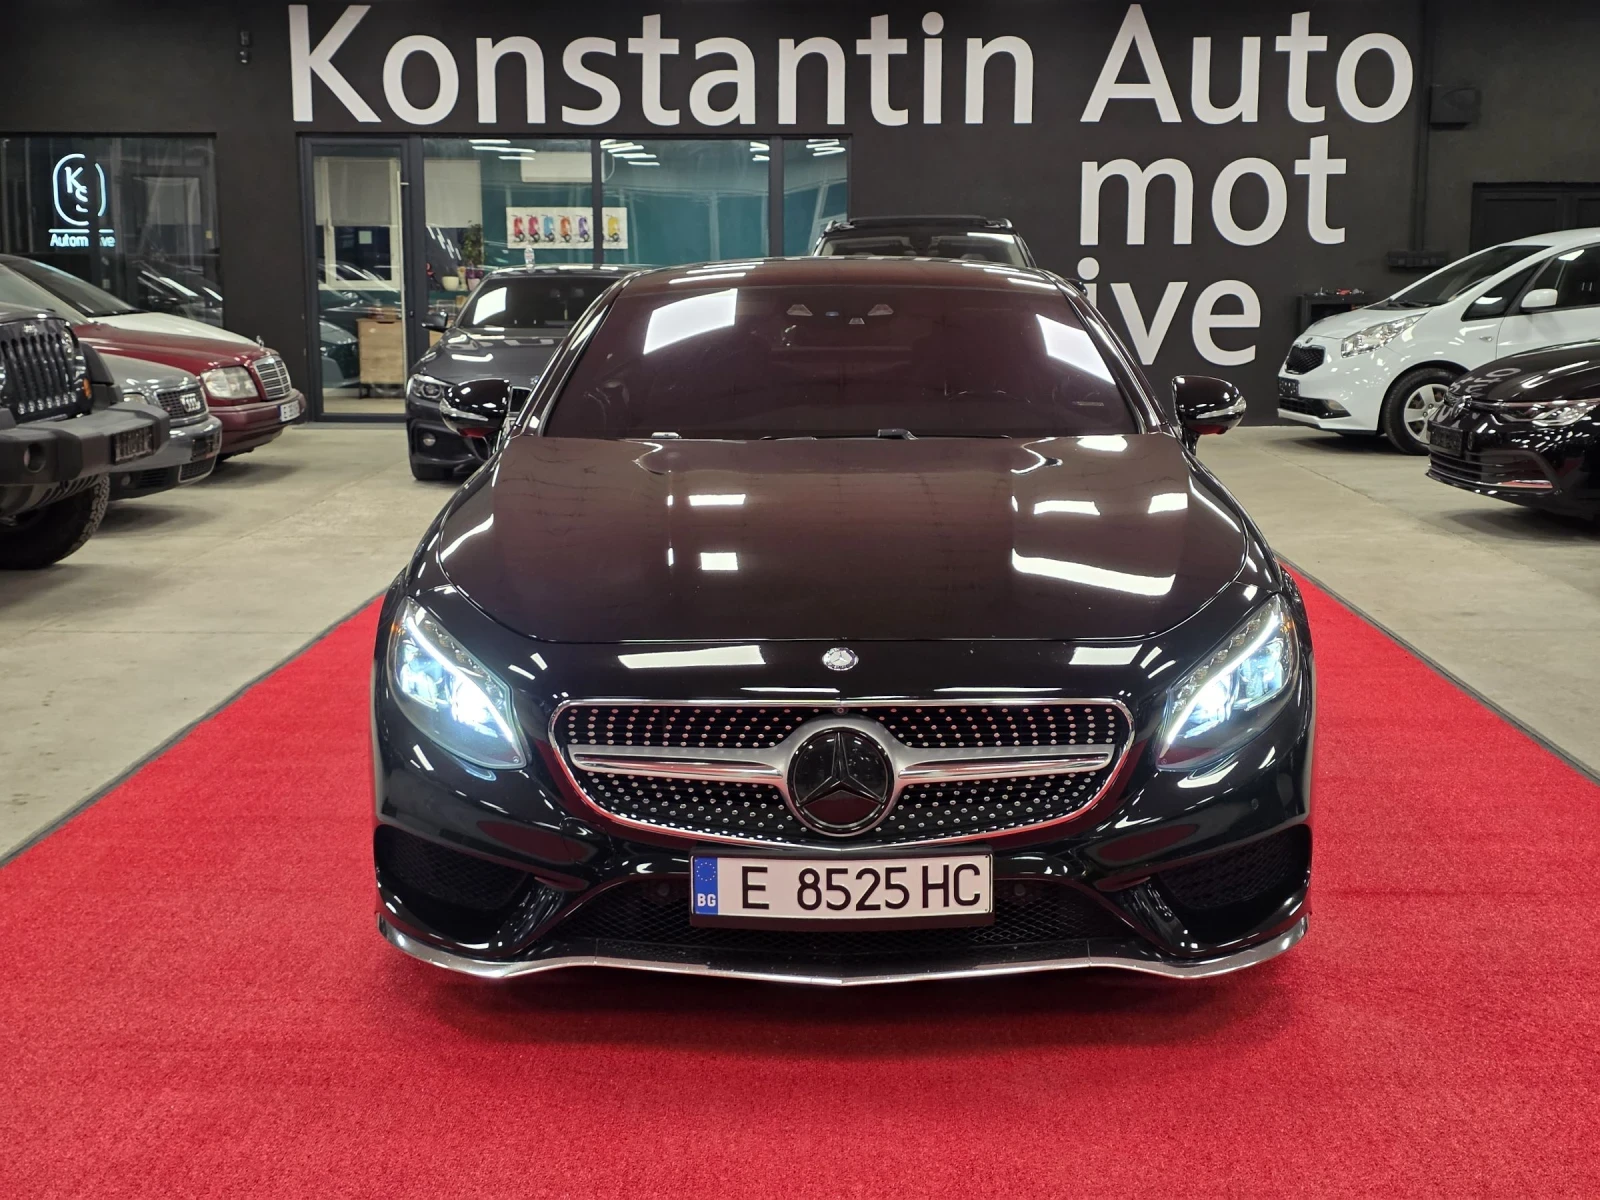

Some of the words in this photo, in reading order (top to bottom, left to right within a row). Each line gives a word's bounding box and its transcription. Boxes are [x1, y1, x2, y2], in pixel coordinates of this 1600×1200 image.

[290, 6, 1033, 126] Konstantin
[1080, 5, 1413, 124] Auto
[1080, 135, 1346, 246] mot
[697, 893, 717, 907] BG
[742, 865, 769, 910] E
[797, 867, 909, 911] 8525
